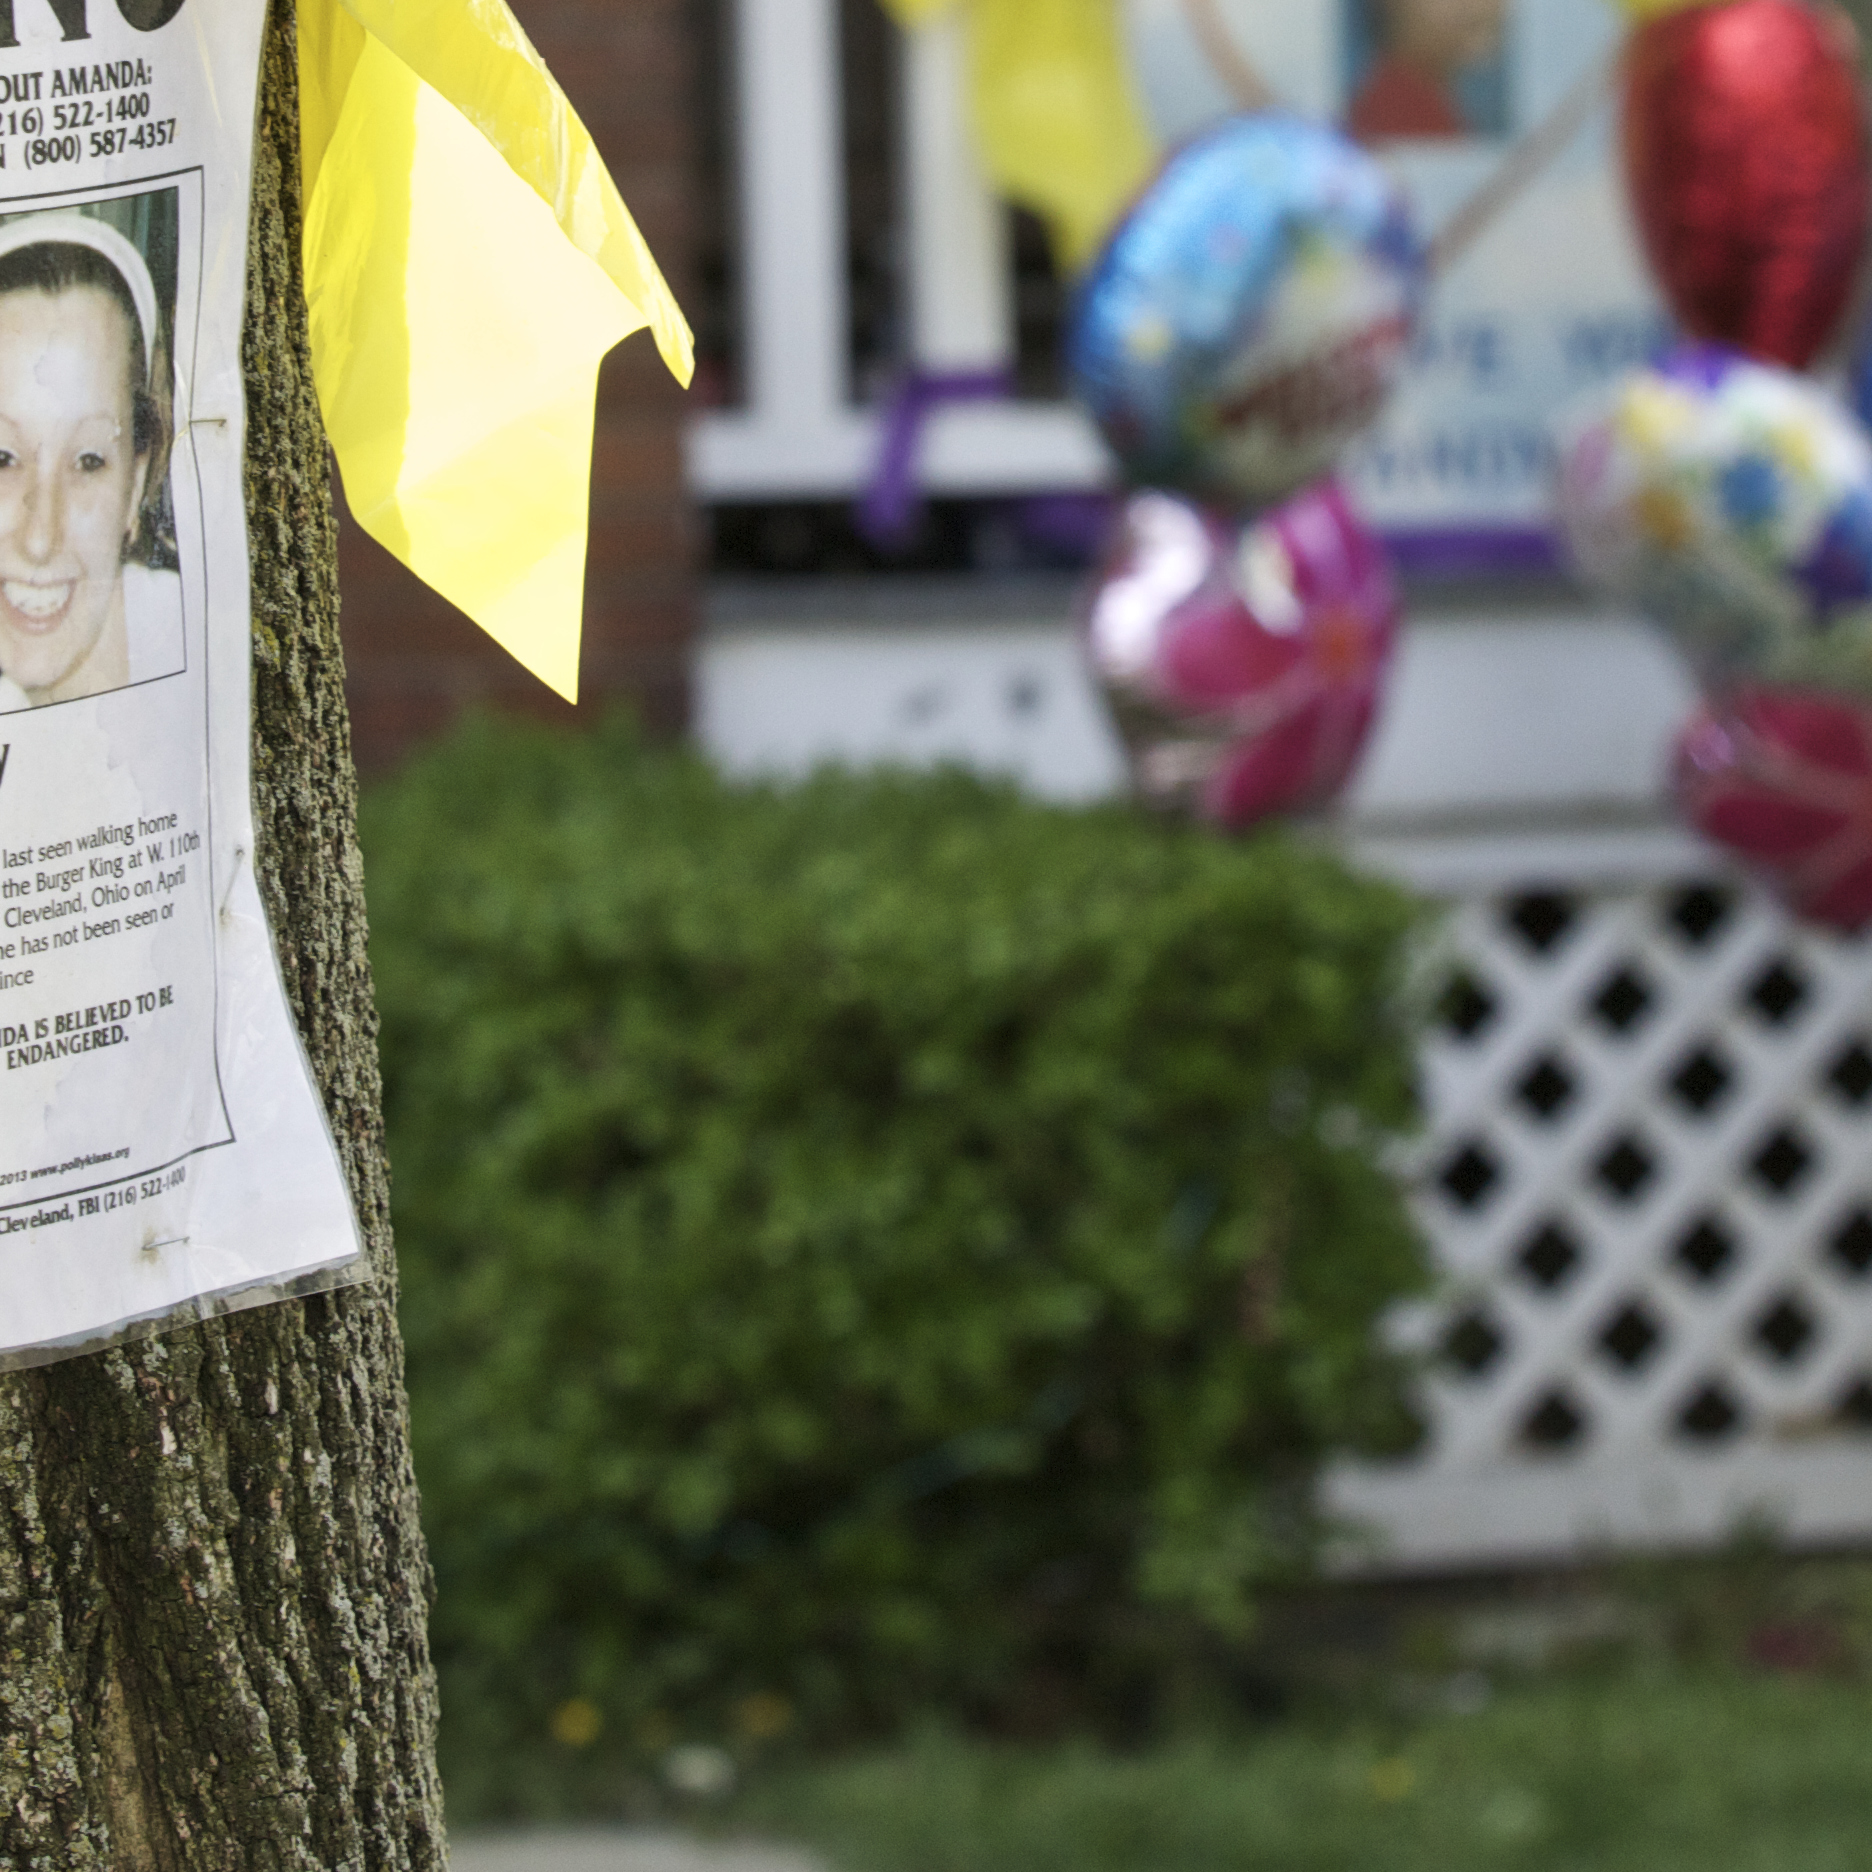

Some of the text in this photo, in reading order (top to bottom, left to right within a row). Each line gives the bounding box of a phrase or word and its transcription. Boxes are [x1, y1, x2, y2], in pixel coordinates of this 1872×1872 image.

[49, 57, 153, 99] AMANDA:
[52, 91, 151, 131] 522-1400
[23, 133, 82, 171] (800)
[89, 117, 177, 158] 587-4357
[1, 877, 31, 900] the
[35, 866, 85, 893] Burger
[88, 856, 125, 879] King
[127, 850, 143, 869] at
[145, 841, 165, 864] W.
[169, 830, 201, 858] 110th
[2, 847, 34, 869] last
[37, 840, 73, 863] seen
[76, 824, 135, 852] walking
[137, 813, 178, 837] home
[3, 892, 88, 929] Cleveland,
[91, 883, 131, 908] Ohio
[133, 879, 154, 898] on
[156, 864, 186, 894] April
[20, 935, 50, 956] has
[52, 925, 79, 949] not
[82, 918, 121, 942] been
[124, 908, 159, 931] seen
[160, 902, 175, 920] or
[34, 1017, 50, 1040] IS
[54, 998, 133, 1036] BELIEVED
[135, 991, 157, 1015] TO
[158, 984, 174, 1009] BE
[6, 1024, 130, 1071] ENDANGERED.
[29, 1146, 131, 1180] www.pollyklaas.org
[77, 1195, 101, 1218] FBI
[103, 1185, 137, 1213] (216)
